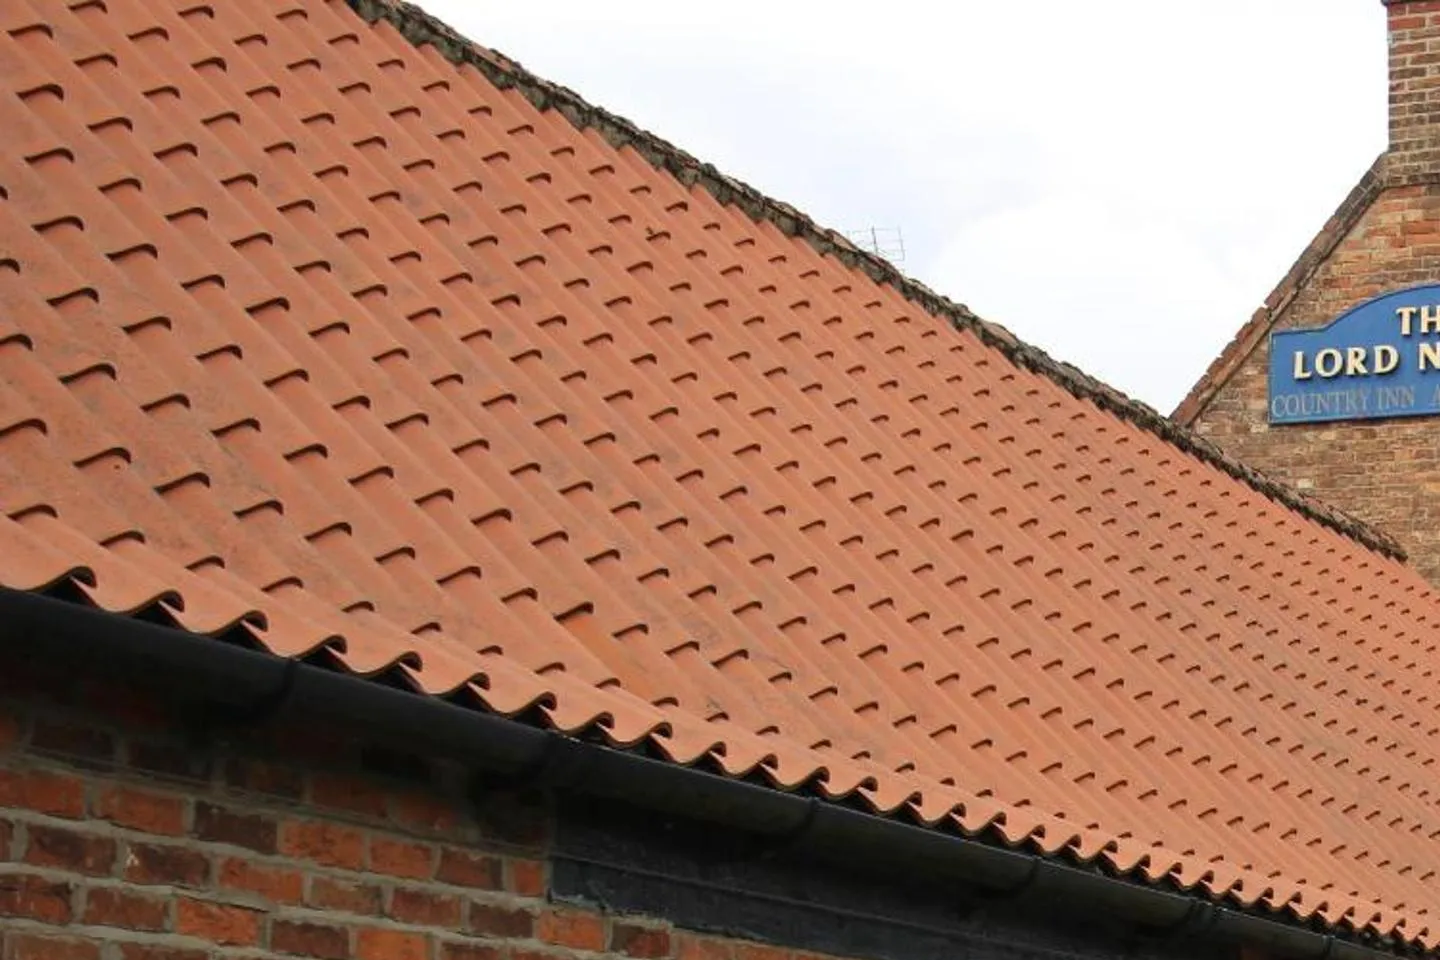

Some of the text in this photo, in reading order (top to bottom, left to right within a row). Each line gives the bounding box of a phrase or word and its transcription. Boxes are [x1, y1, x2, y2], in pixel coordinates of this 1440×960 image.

[1294, 345, 1399, 380] LORD
[1272, 387, 1371, 418] COUNTRY
[1376, 385, 1416, 411] INN
